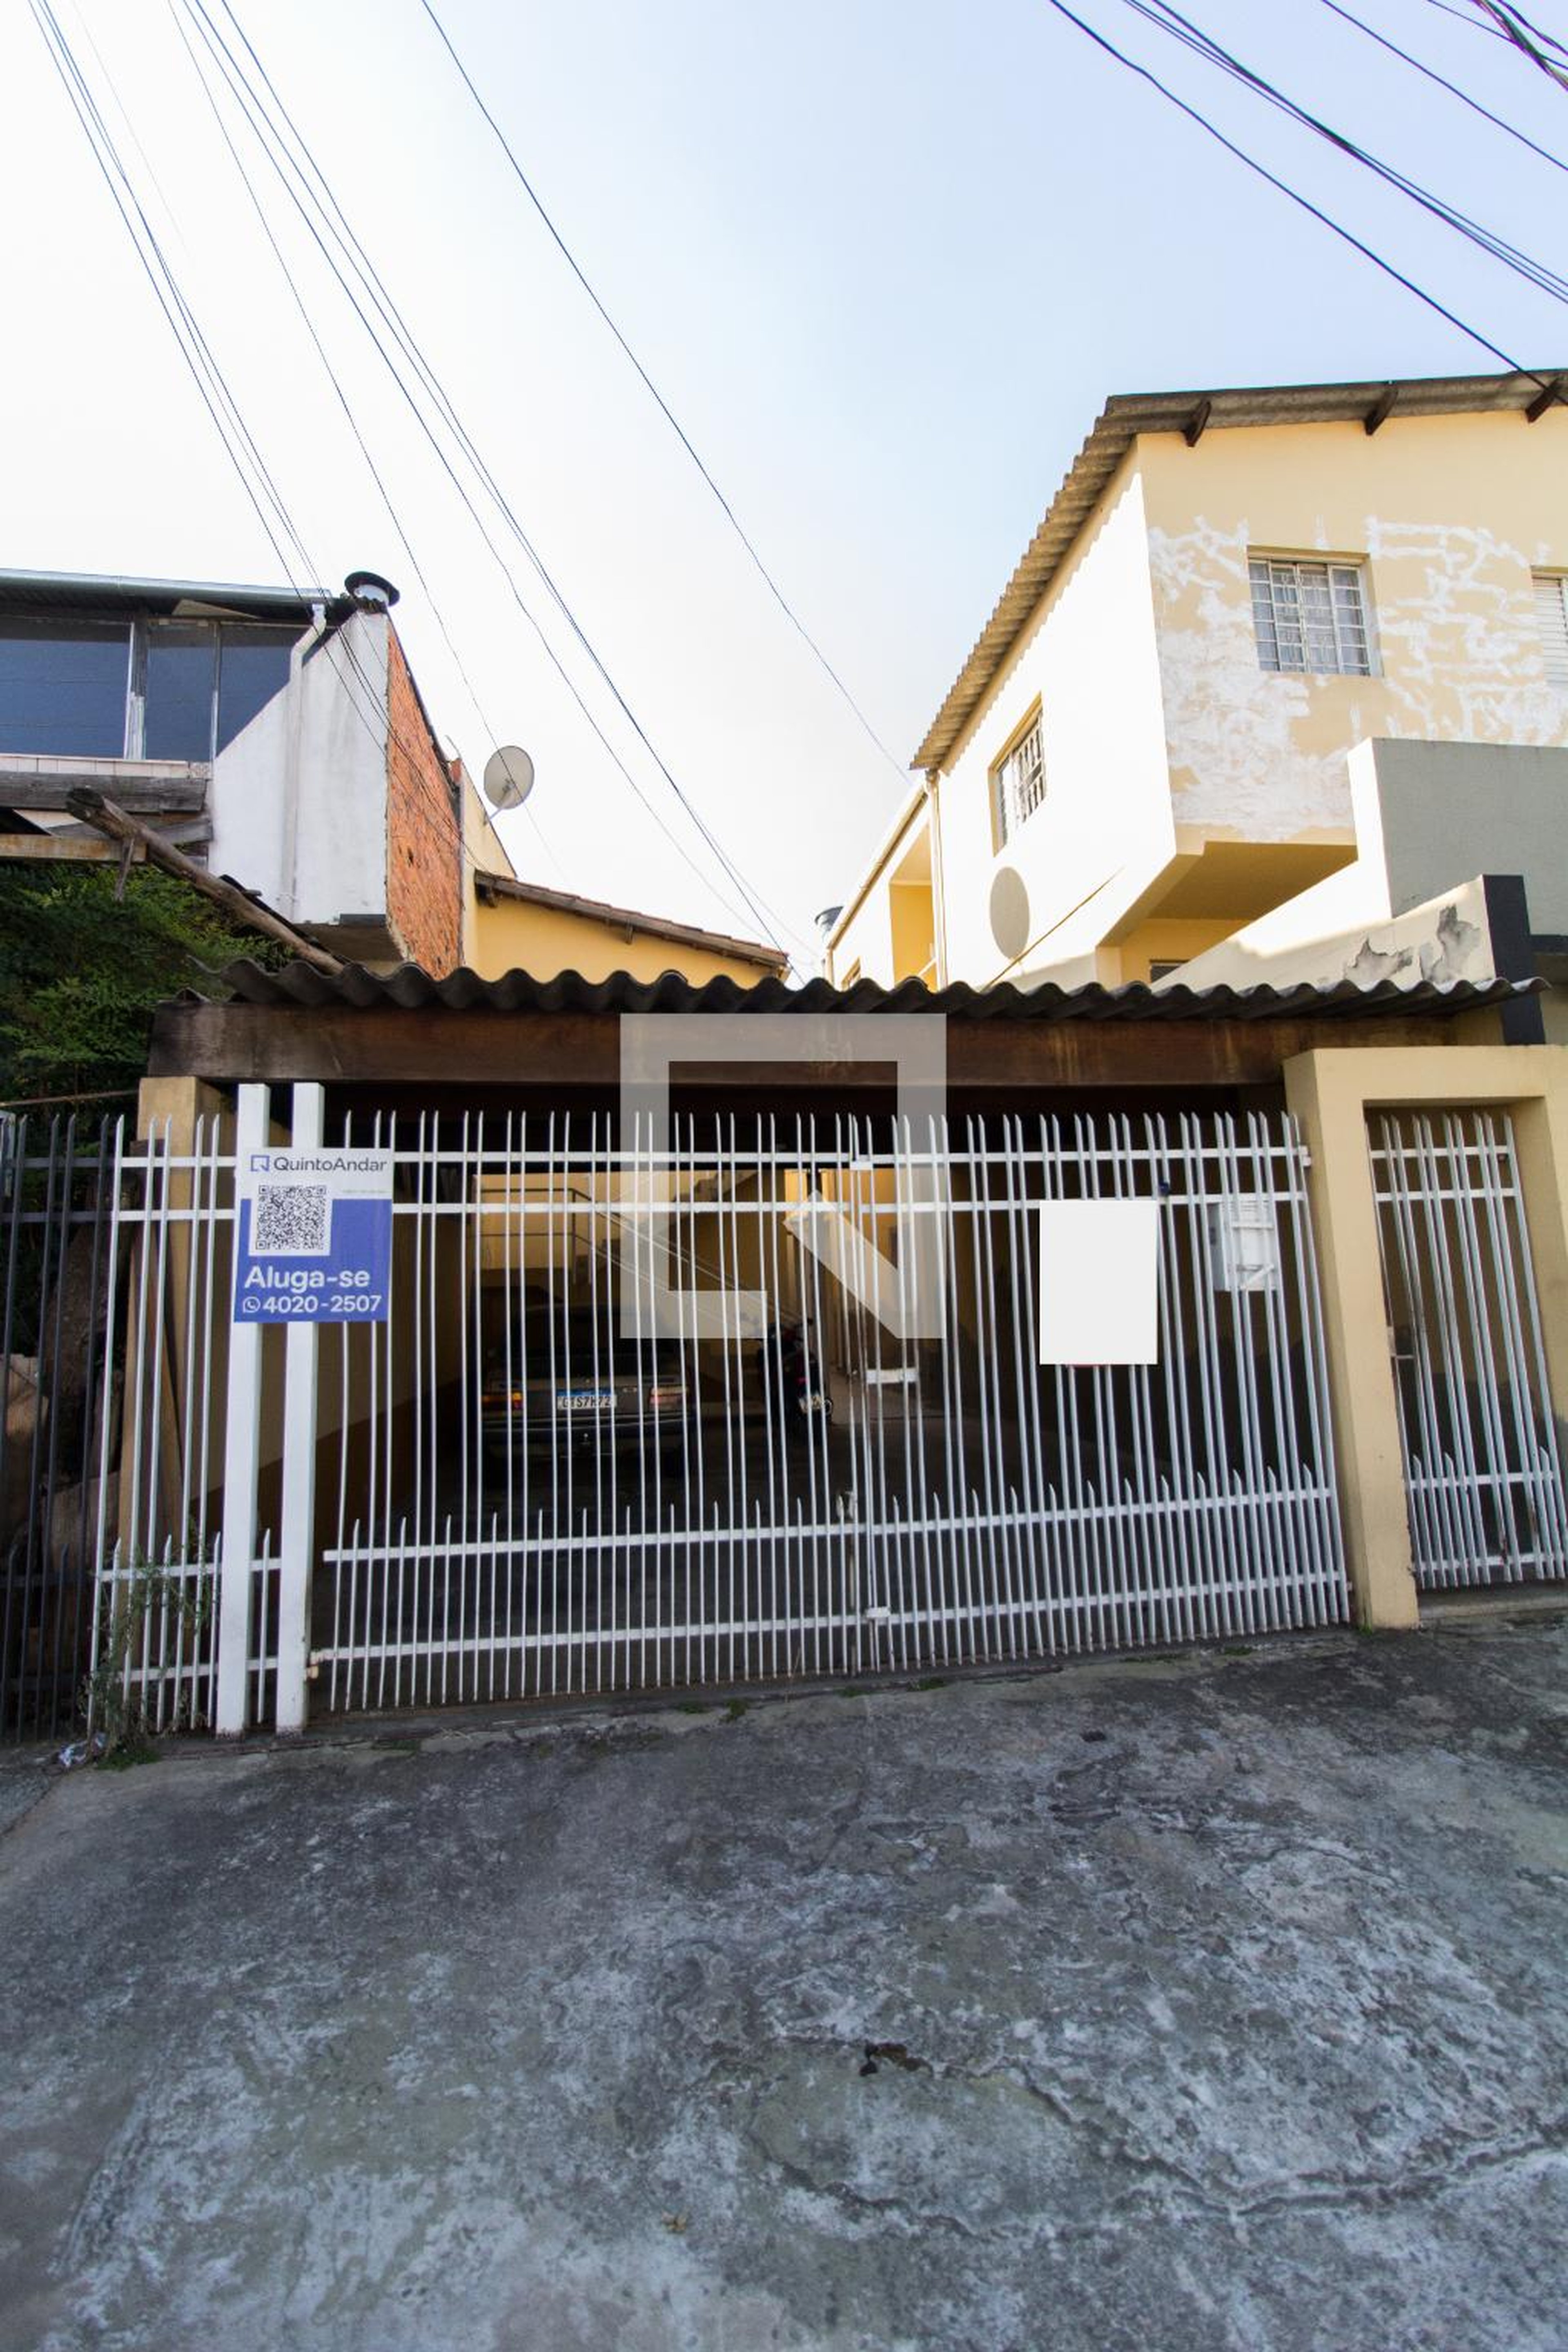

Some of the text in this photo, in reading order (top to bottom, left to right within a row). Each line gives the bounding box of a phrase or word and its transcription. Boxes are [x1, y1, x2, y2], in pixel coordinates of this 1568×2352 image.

[274, 1156, 387, 1172] QuintoAndar
[244, 1266, 370, 1294] Aluga-se
[263, 1295, 382, 1314] 4020-2507
